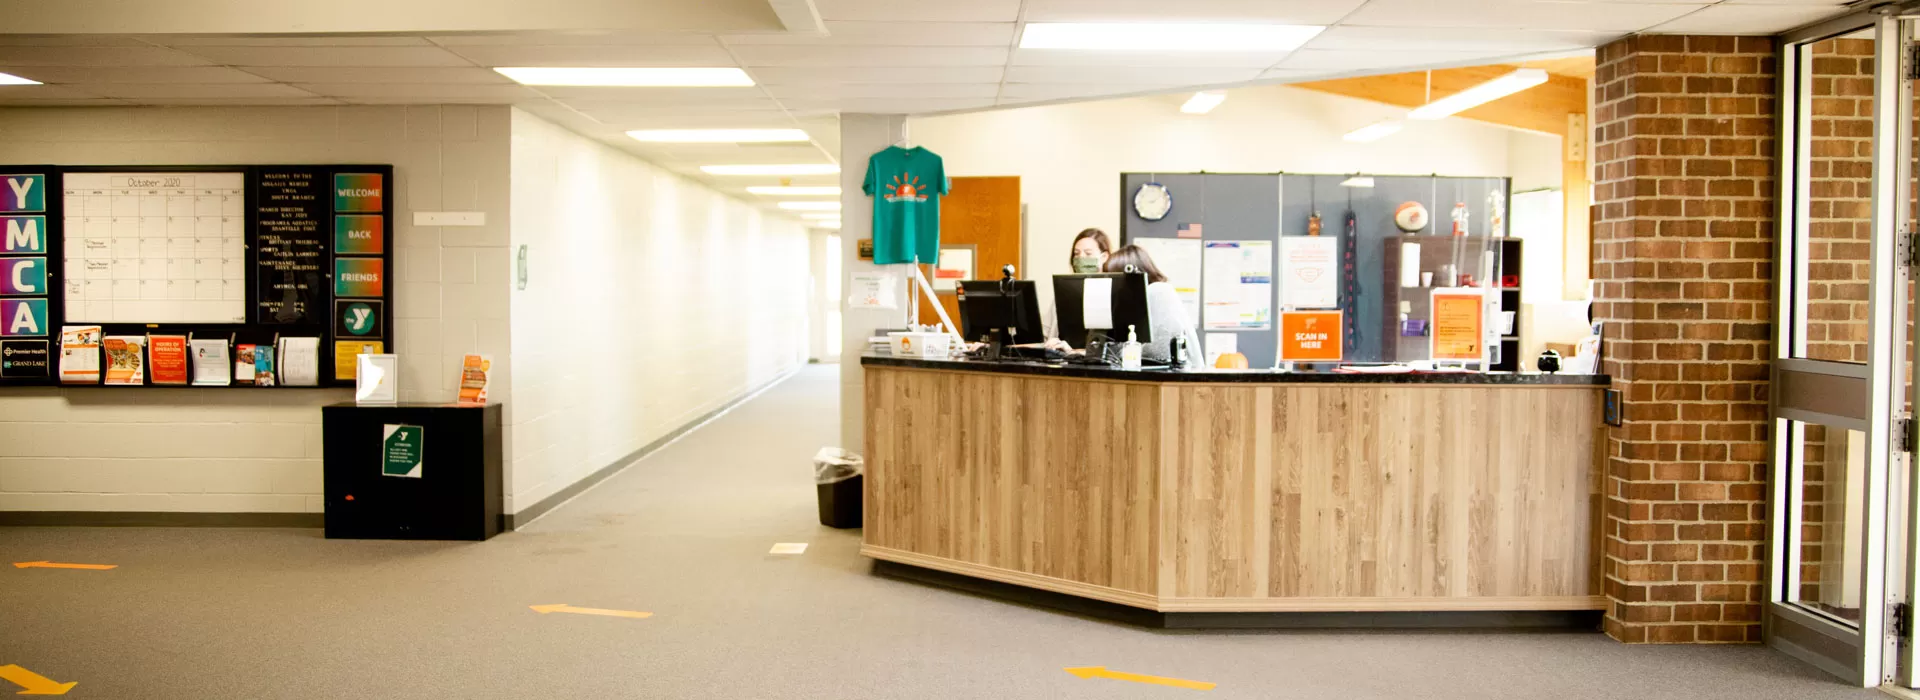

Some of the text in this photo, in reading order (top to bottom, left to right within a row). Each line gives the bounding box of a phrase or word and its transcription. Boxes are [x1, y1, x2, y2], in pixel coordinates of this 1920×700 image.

[128, 177, 181, 187] October 2020
[338, 188, 380, 197] WELCOME
[348, 230, 371, 239] BACK
[6, 178, 39, 333] Y M C A
[341, 273, 378, 282] FRIENDS
